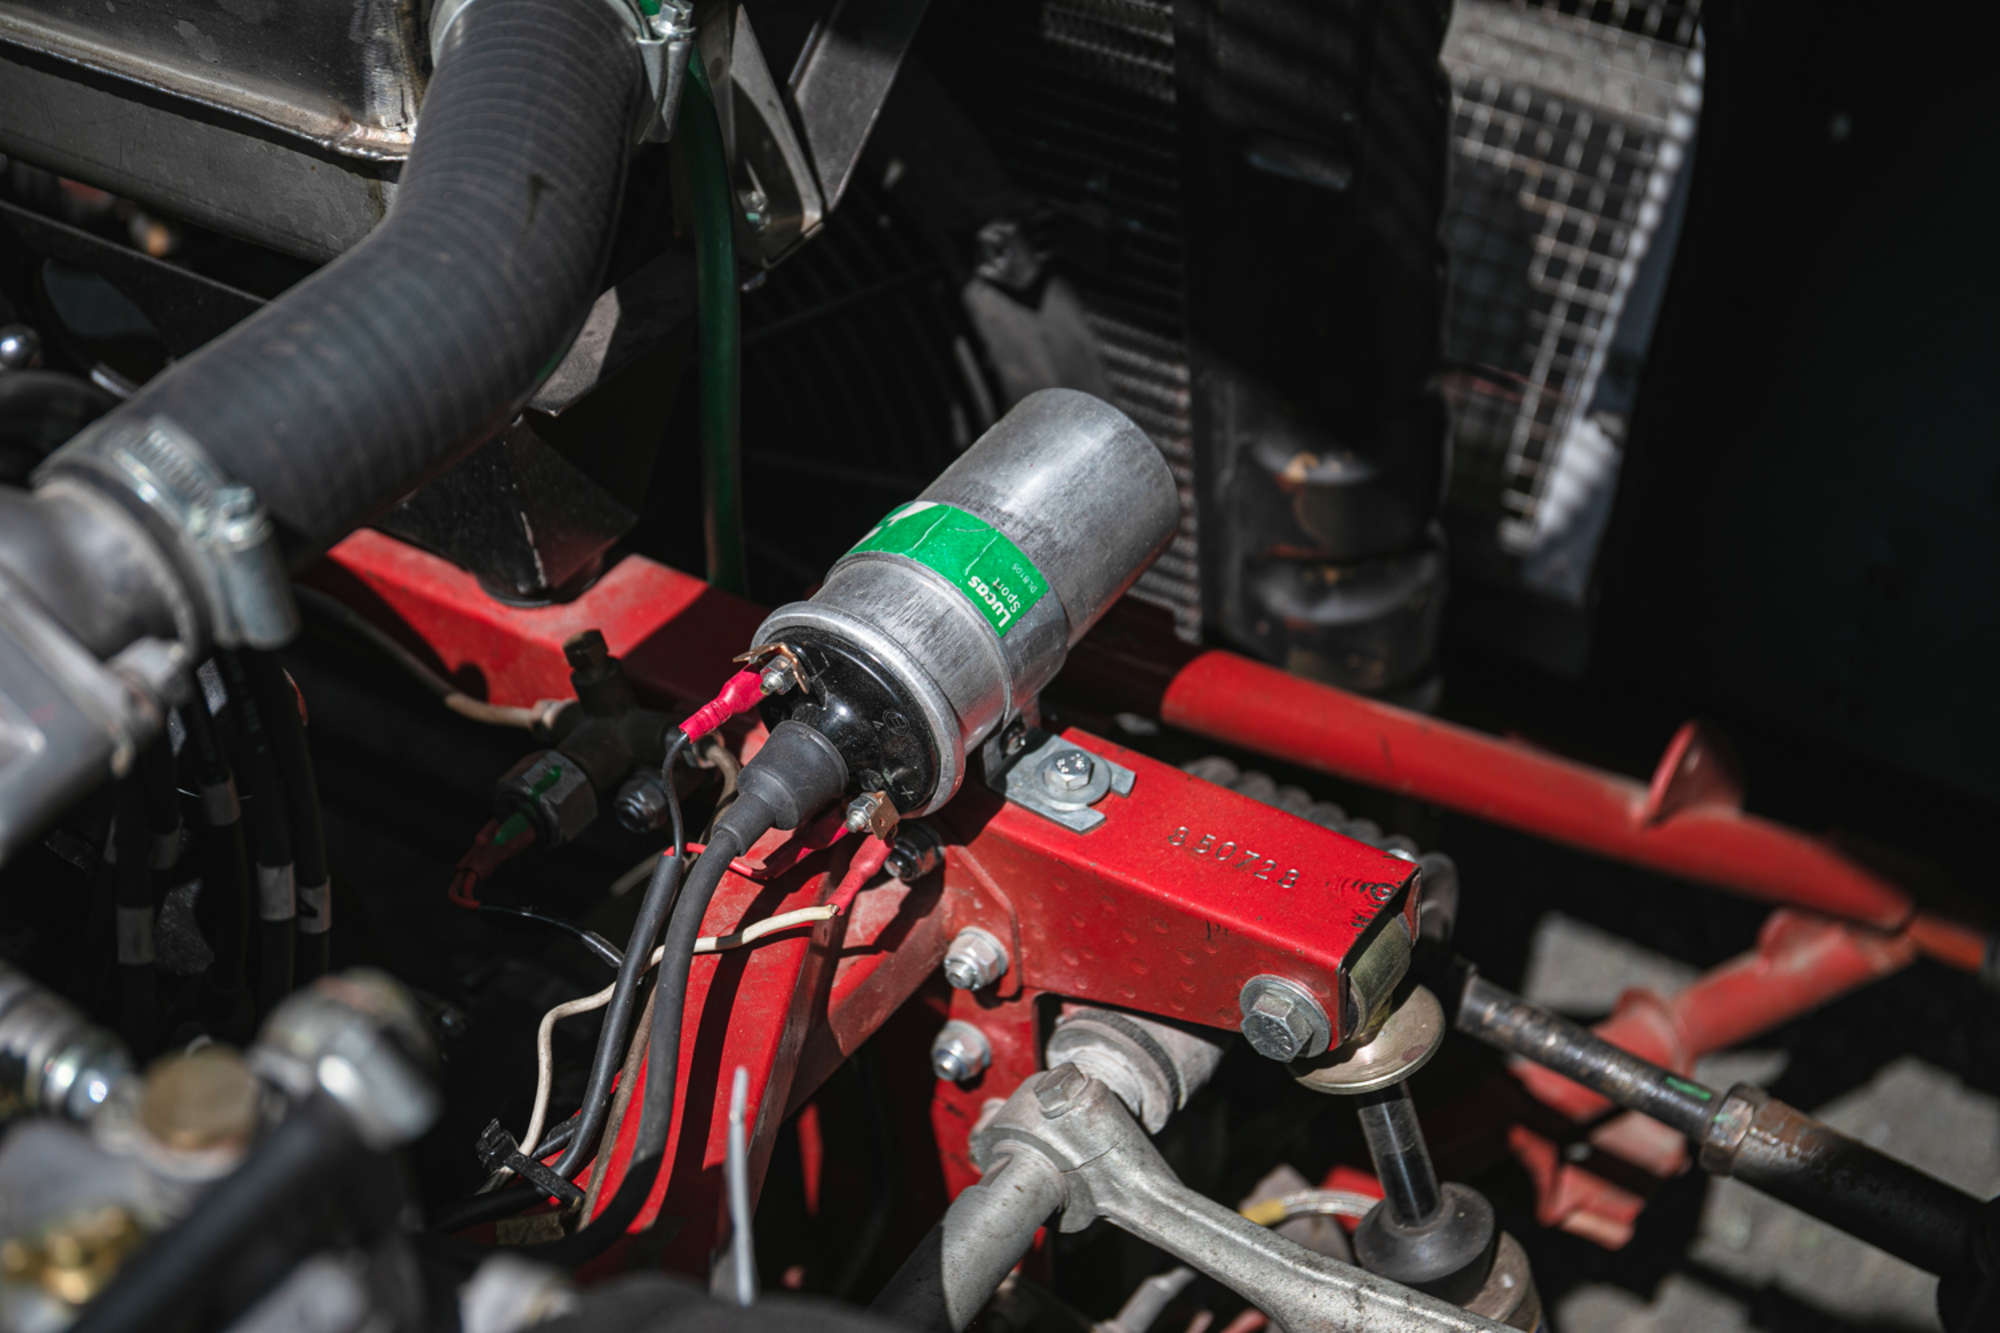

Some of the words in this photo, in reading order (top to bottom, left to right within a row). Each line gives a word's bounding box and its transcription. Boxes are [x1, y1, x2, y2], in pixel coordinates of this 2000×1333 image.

[967, 575, 1011, 628] Lucas
[992, 577, 1021, 613] Sport
[1168, 826, 1300, 889] 850728
